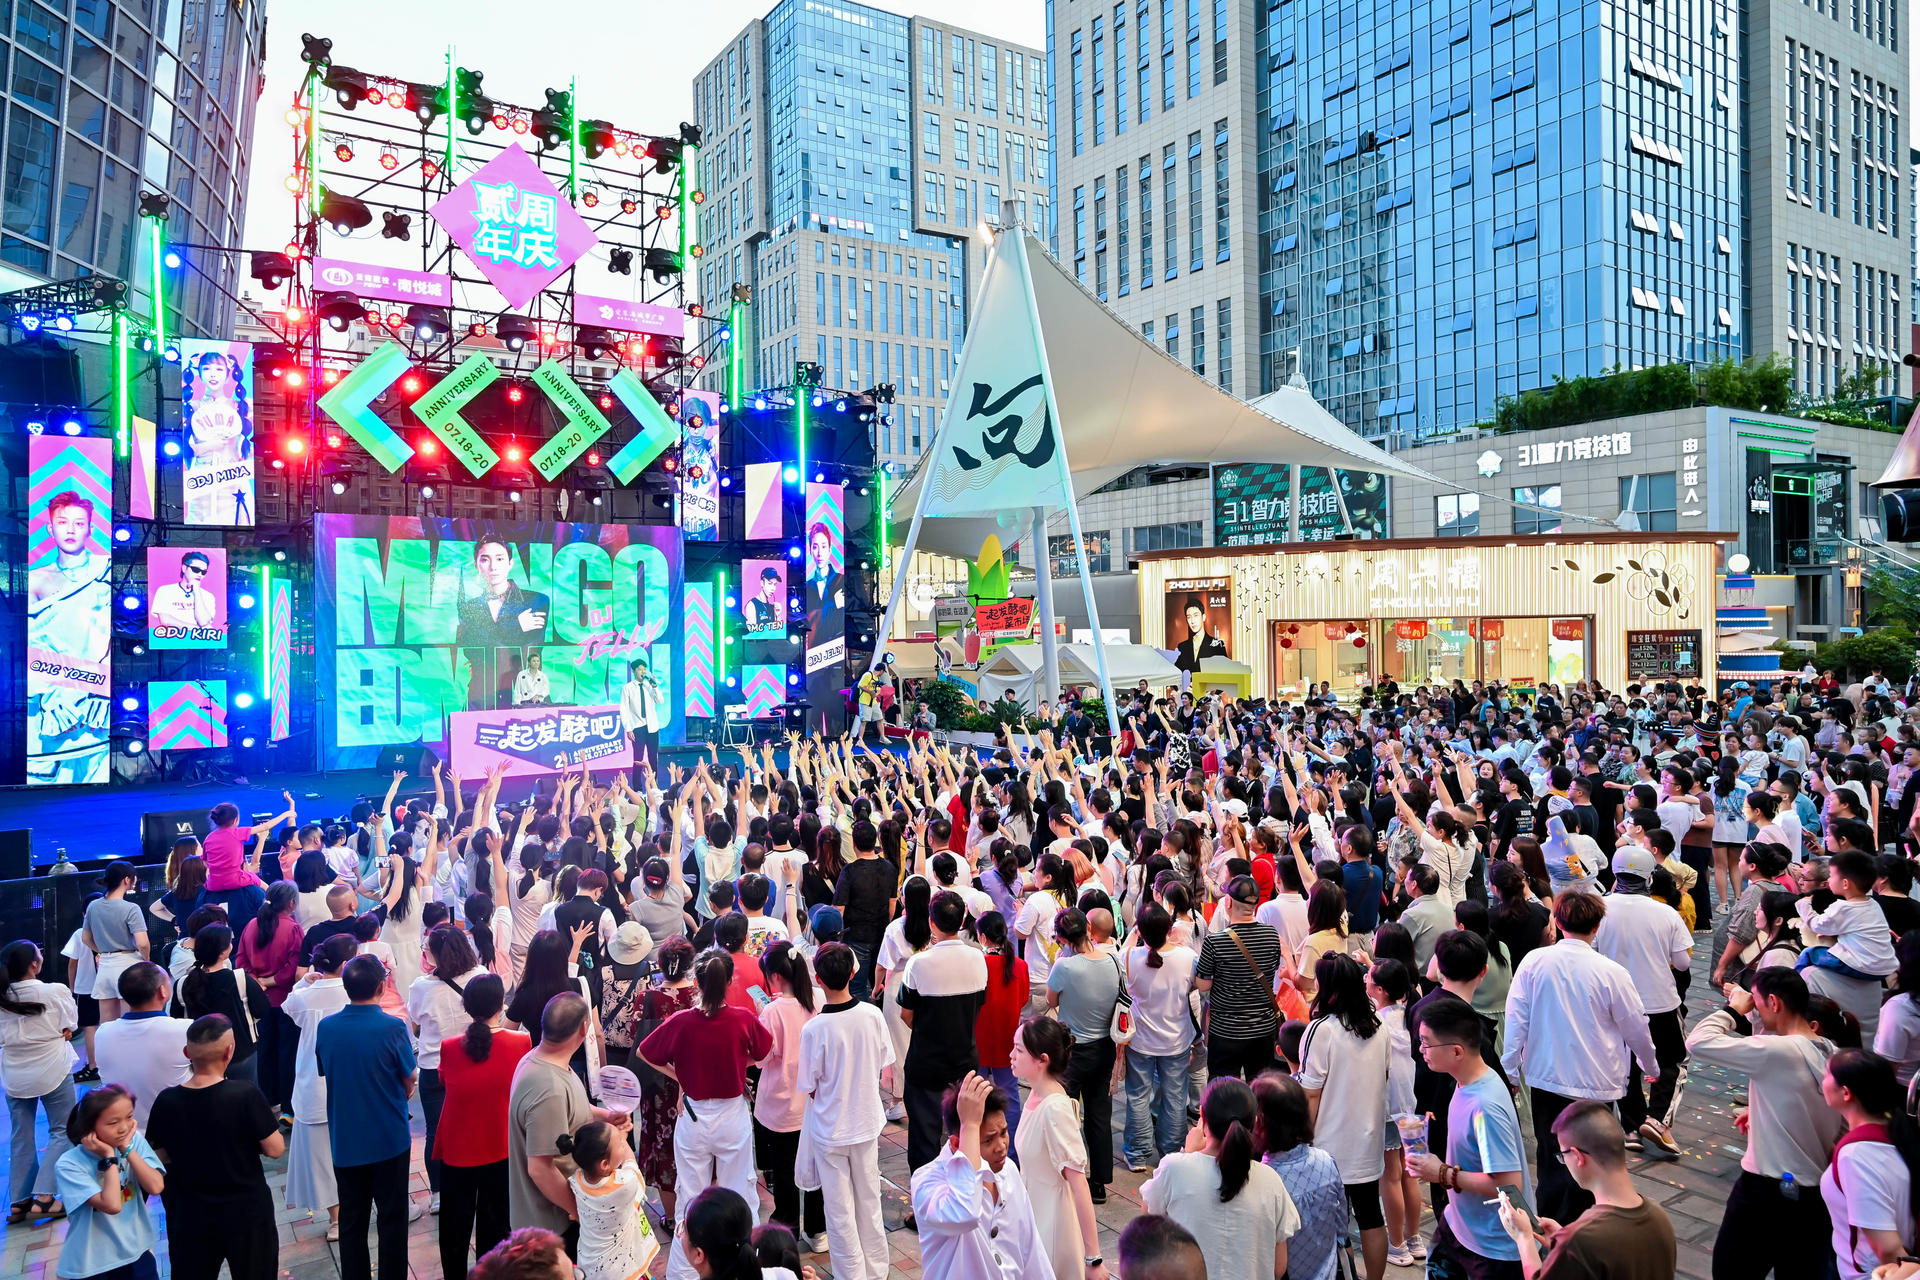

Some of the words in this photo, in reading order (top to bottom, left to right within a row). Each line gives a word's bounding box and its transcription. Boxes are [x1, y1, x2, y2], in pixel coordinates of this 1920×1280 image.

[473, 224, 562, 270] 年庆
[424, 361, 490, 420] ANNIVERSARY
[542, 369, 602, 435] ANNIVERSARY
[444, 421, 490, 470] 07.18~20
[539, 432, 583, 472] 07.18~20
[1518, 431, 1632, 467] 31智力竞技馆
[186, 474, 213, 490] @DJ
[215, 464, 250, 483] MINA
[1169, 580, 1194, 590] ZHOU
[1212, 578, 1227, 588] FU
[589, 604, 613, 629] DJ
[766, 621, 784, 632] TEN
[978, 602, 1031, 621] 一起发酵吧
[153, 626, 188, 640] @DJ
[190, 627, 223, 641] KIRI
[573, 616, 666, 666] JELLY
[806, 655, 823, 668] @DJ
[823, 645, 845, 661] JELLY
[29, 660, 62, 676] @MC
[62, 666, 107, 686] YOZEN
[479, 713, 622, 752] 一起发酵吧
